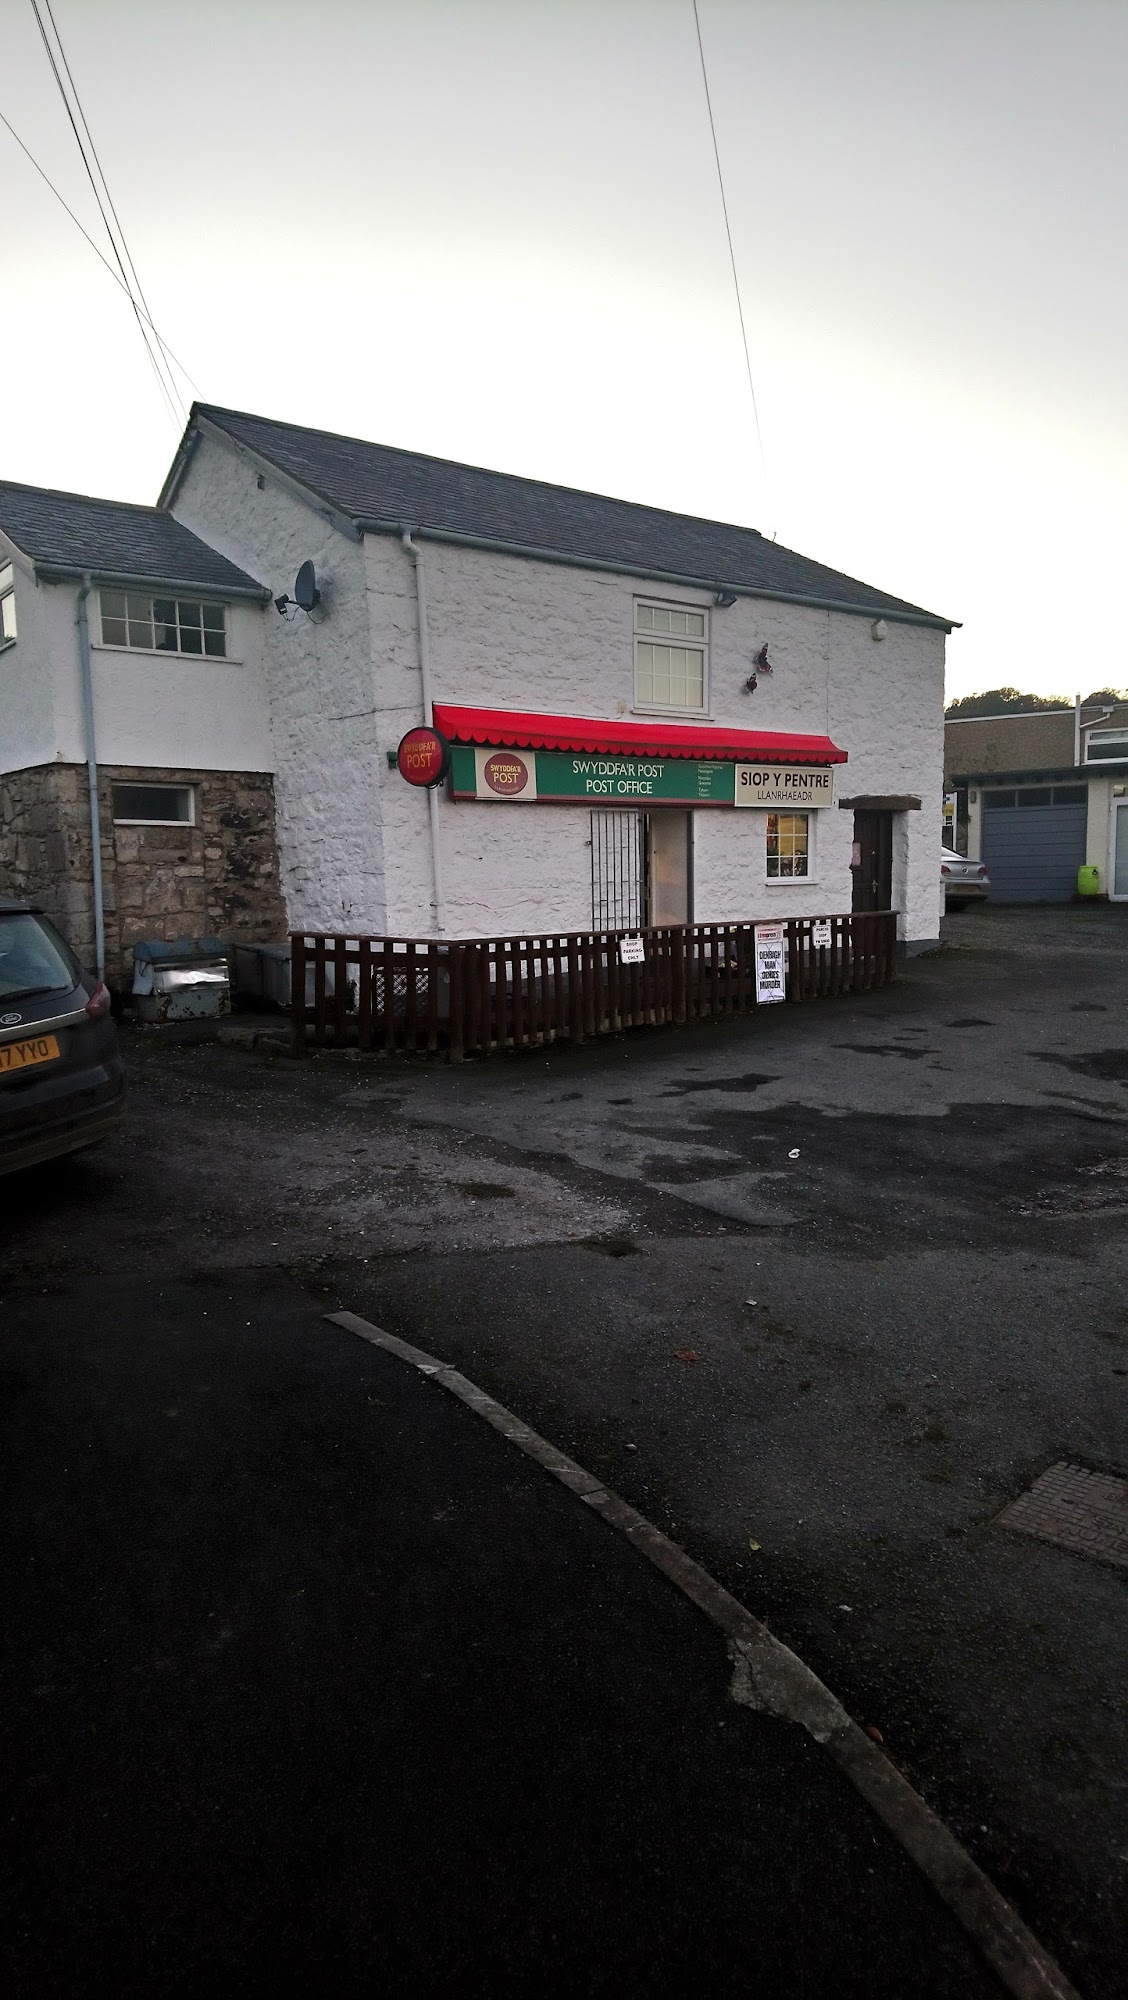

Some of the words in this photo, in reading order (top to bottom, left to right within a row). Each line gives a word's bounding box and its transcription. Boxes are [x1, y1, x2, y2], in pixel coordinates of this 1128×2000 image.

[404, 741, 436, 753] SWYDDFA'R
[407, 752, 433, 768] POST
[490, 764, 521, 773] SWYDDFA'R
[572, 760, 635, 777] SWYDDFA'R
[637, 764, 664, 778] POST
[493, 773, 519, 783] POST
[741, 771, 770, 786] SIOP
[773, 773, 781, 787] Y
[784, 773, 829, 788] PENTRE
[586, 779, 614, 793] POST
[617, 780, 653, 794] OFFICE
[757, 790, 813, 801] LLANRHAEADR
[760, 980, 781, 990] MURDER
[0, 1048, 11, 1067] 7
